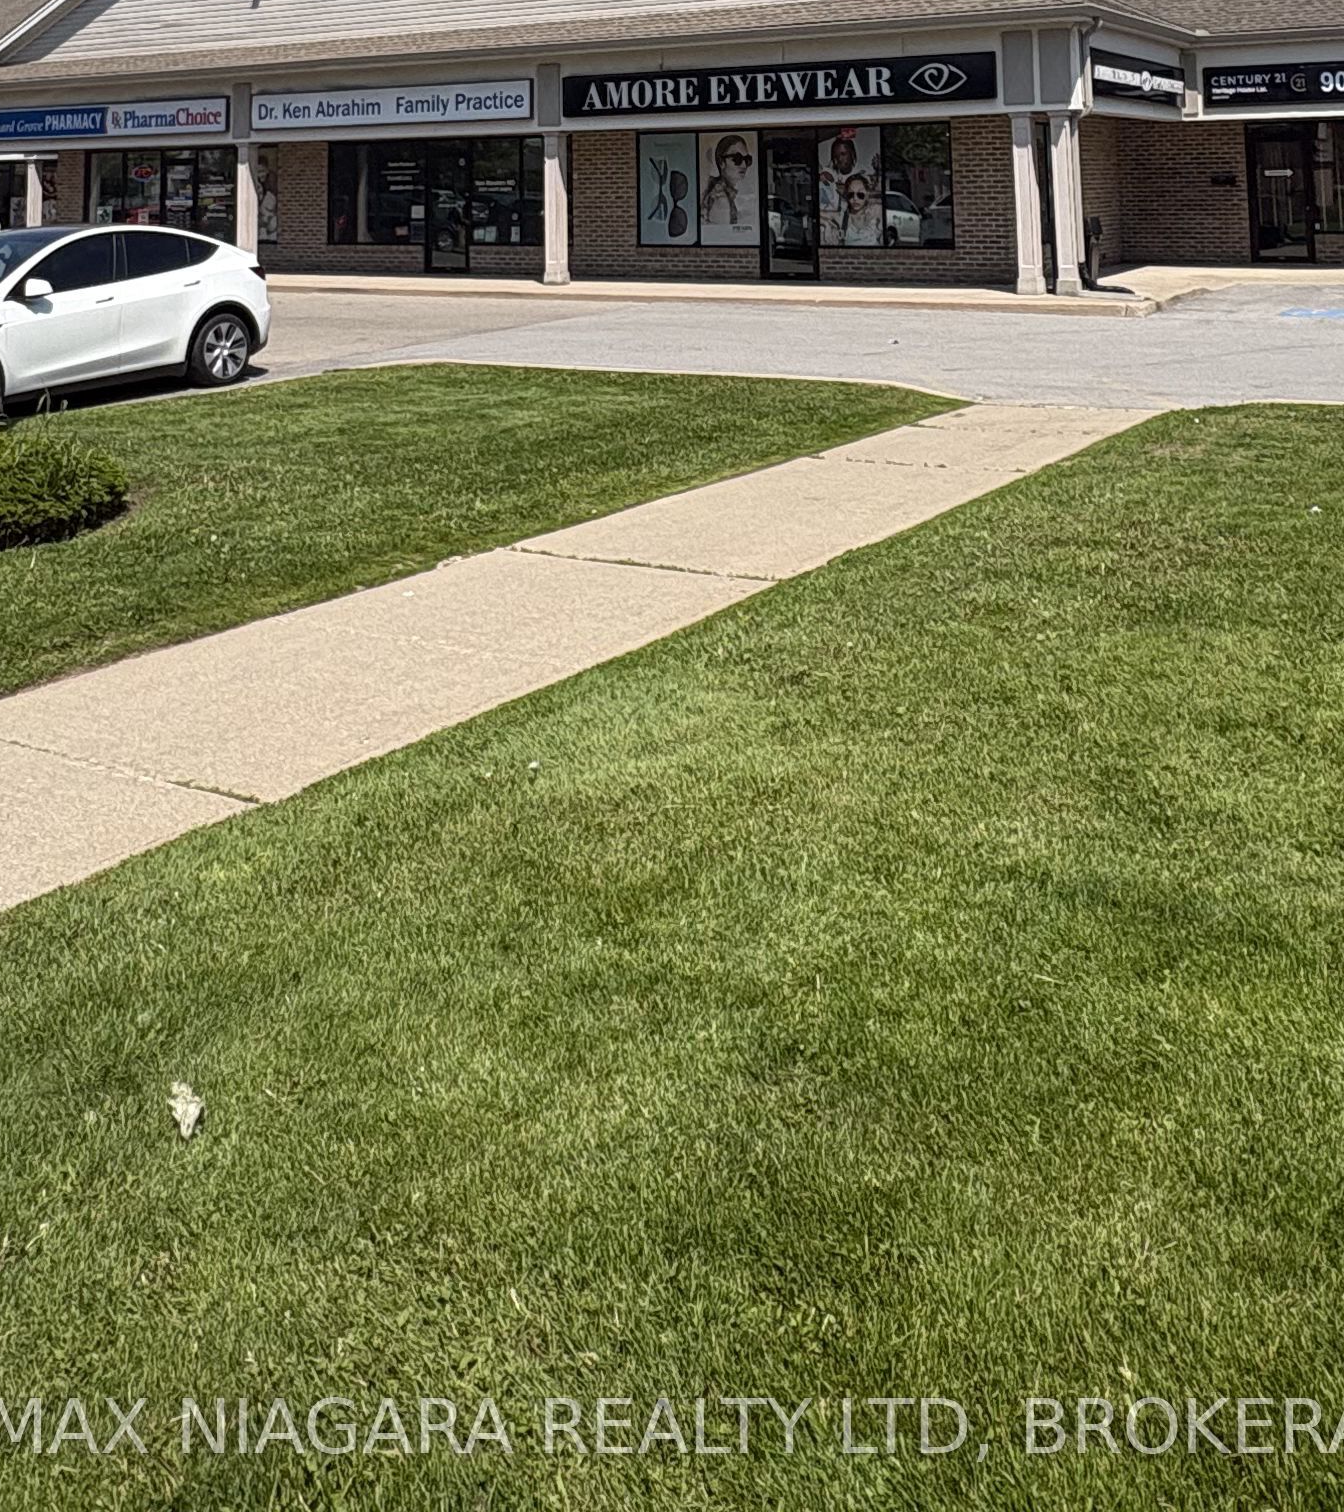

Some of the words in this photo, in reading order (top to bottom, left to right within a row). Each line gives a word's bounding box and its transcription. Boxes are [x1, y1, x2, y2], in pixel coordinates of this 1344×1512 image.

[581, 77, 699, 111] AMORE
[706, 66, 895, 105] EYEWEAR
[1210, 73, 1272, 86] CENTURY
[1273, 72, 1287, 84] 21
[123, 106, 222, 129] PharmaChoice
[257, 103, 279, 121] Dr.
[282, 102, 311, 119] Ken
[315, 98, 382, 118] Abrahim
[395, 95, 450, 116] Family
[455, 91, 525, 111] Practice
[17, 120, 44, 133] Grove
[44, 111, 103, 131] PHARMACY
